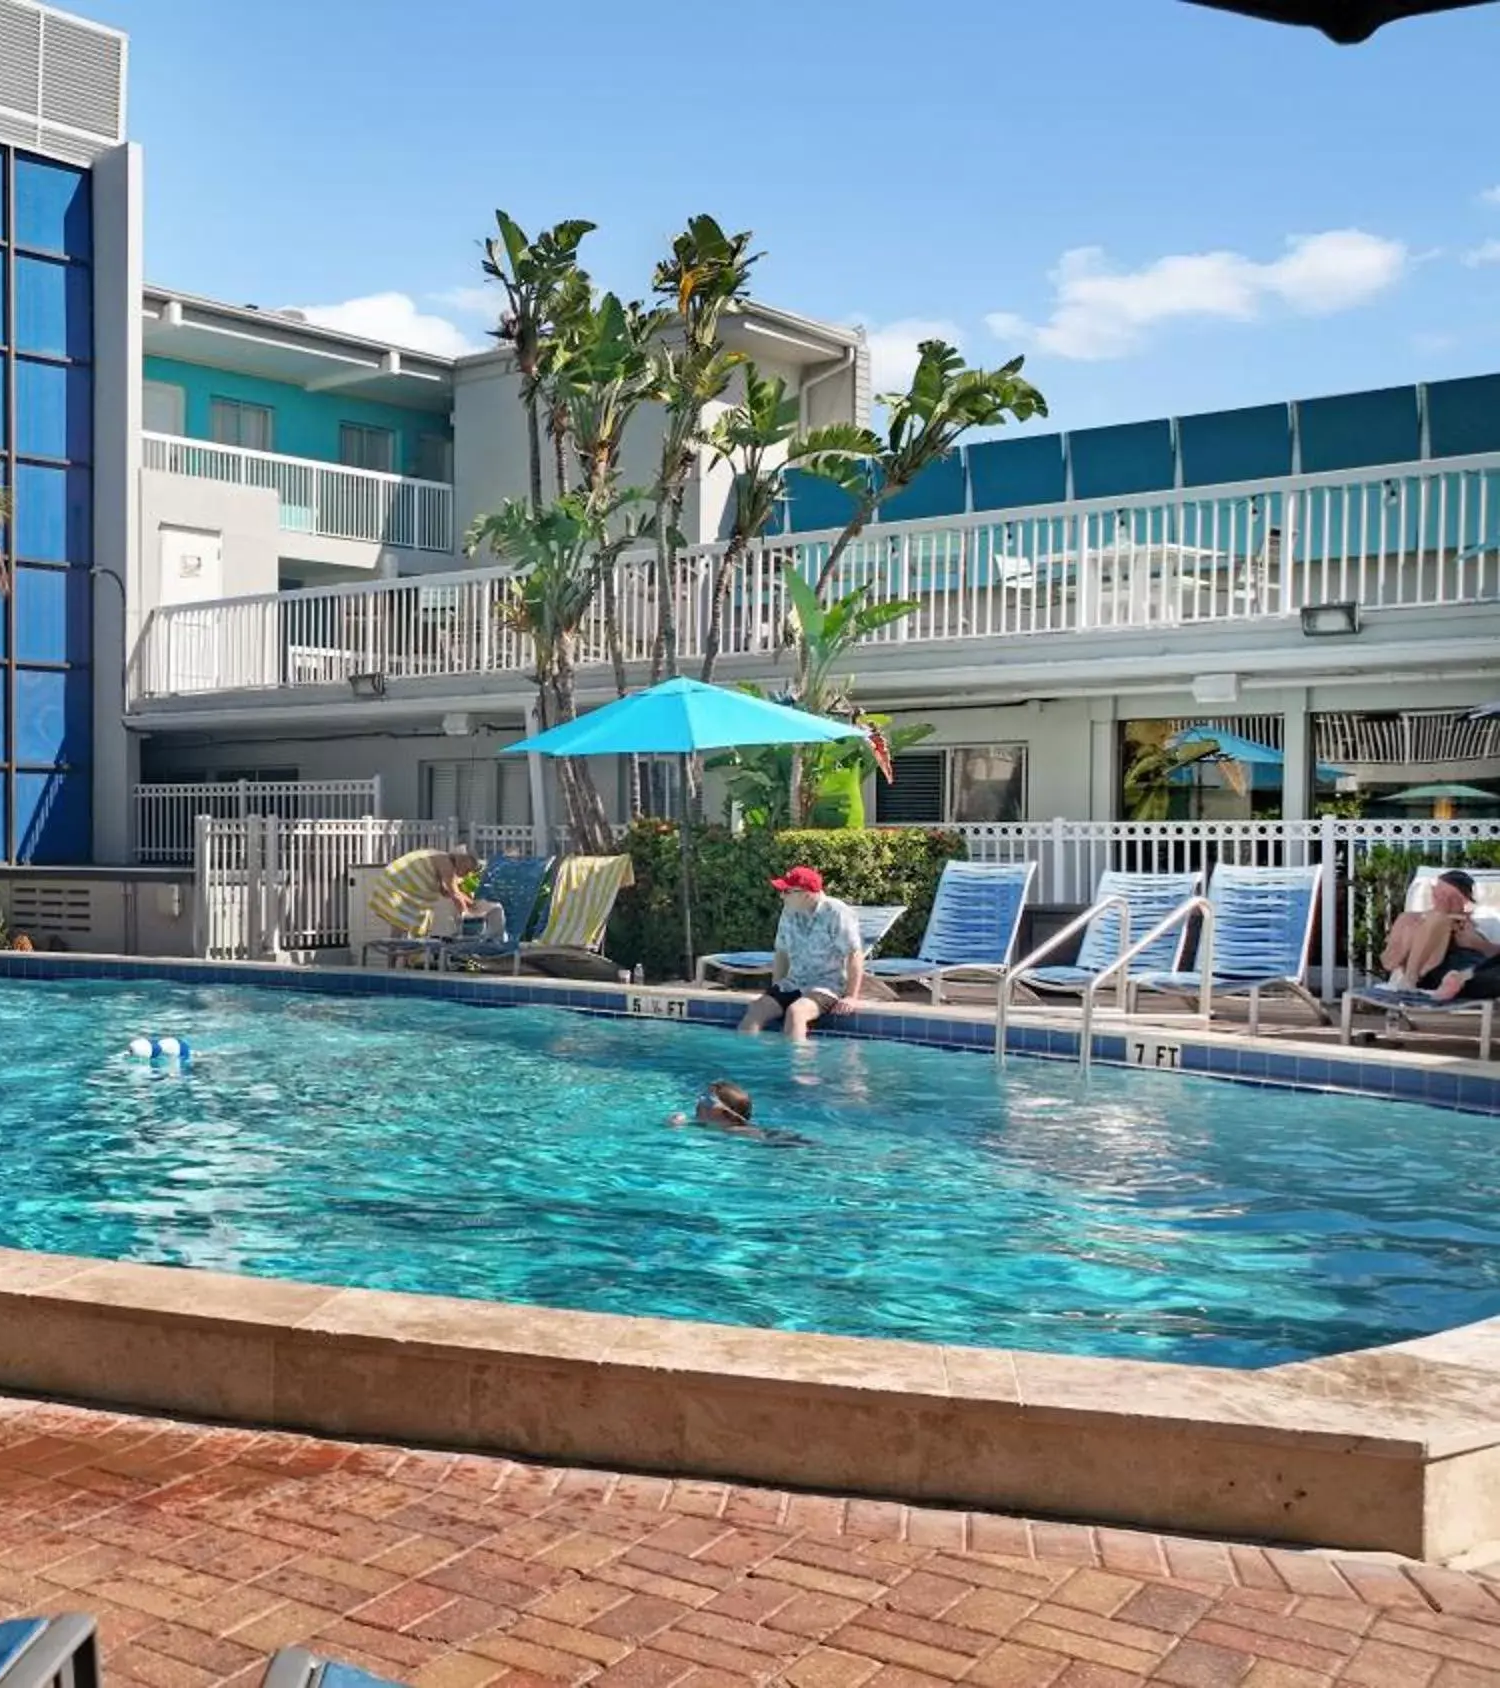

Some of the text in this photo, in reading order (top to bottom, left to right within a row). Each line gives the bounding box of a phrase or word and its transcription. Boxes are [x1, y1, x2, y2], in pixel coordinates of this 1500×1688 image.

[633, 997, 641, 1013] 5
[667, 1001, 685, 1018] FT
[1134, 1043, 1179, 1068] 7 FT
